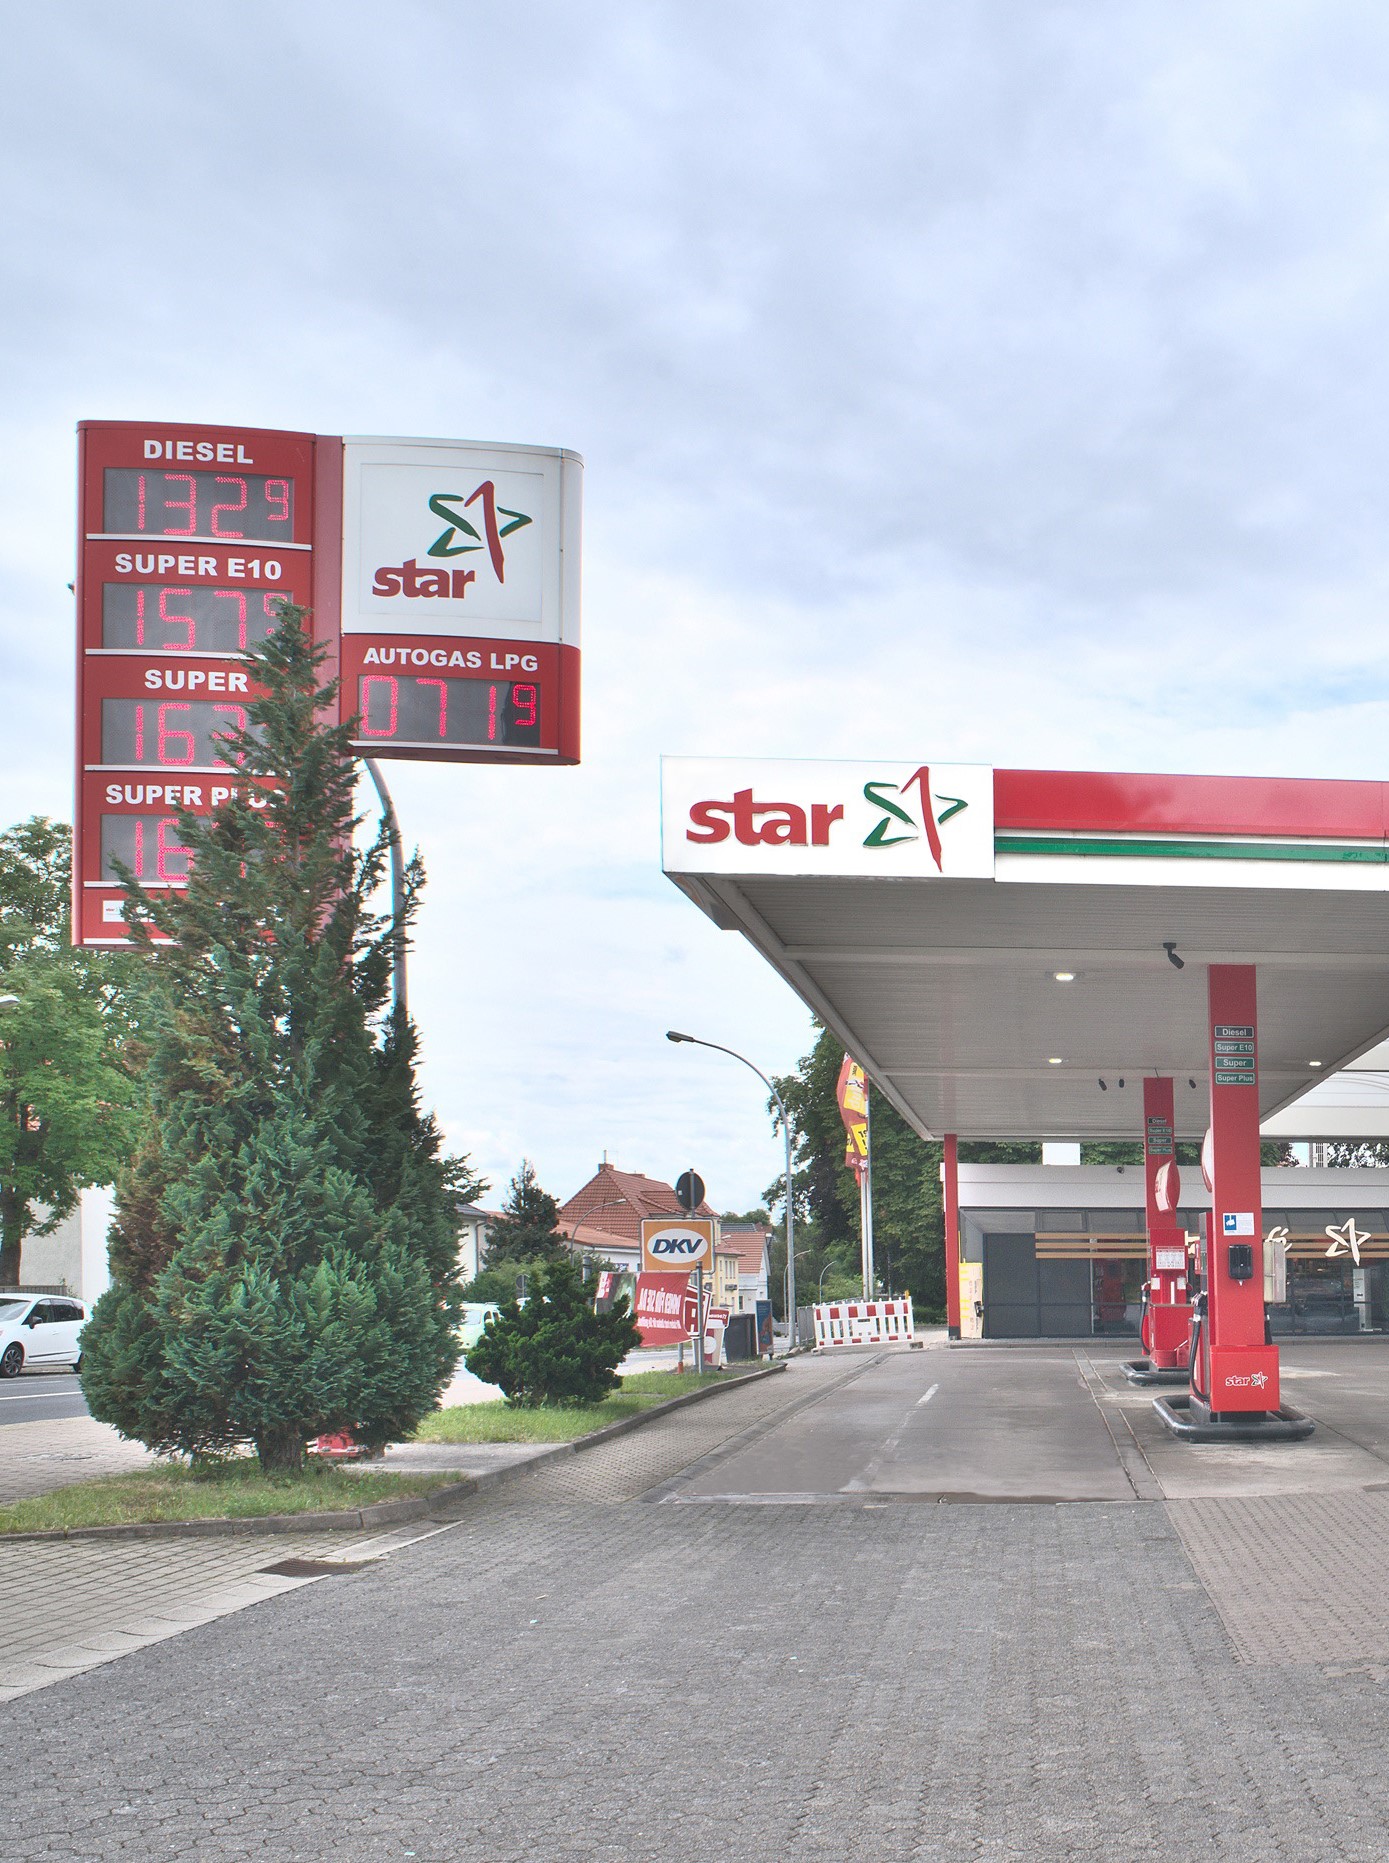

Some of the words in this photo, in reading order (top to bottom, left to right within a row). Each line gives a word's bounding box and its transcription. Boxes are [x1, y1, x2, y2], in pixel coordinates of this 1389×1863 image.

[144, 439, 254, 465] DIESEL
[137, 473, 290, 538] 1329
[114, 553, 218, 576] SUPER
[227, 558, 282, 580] E10
[372, 558, 476, 599] star
[363, 647, 482, 669] AUTOGAS
[490, 653, 538, 671] LPG
[144, 669, 249, 692] SUPER
[361, 674, 537, 741] 0719
[105, 784, 203, 806] SUPER
[686, 788, 844, 846] star
[1222, 1028, 1247, 1036] Diesel
[1217, 1044, 1238, 1052] Super
[1223, 1059, 1247, 1068] Super
[1217, 1074, 1237, 1082] Super
[652, 1239, 703, 1254] DKV
[1225, 1375, 1250, 1386] star
